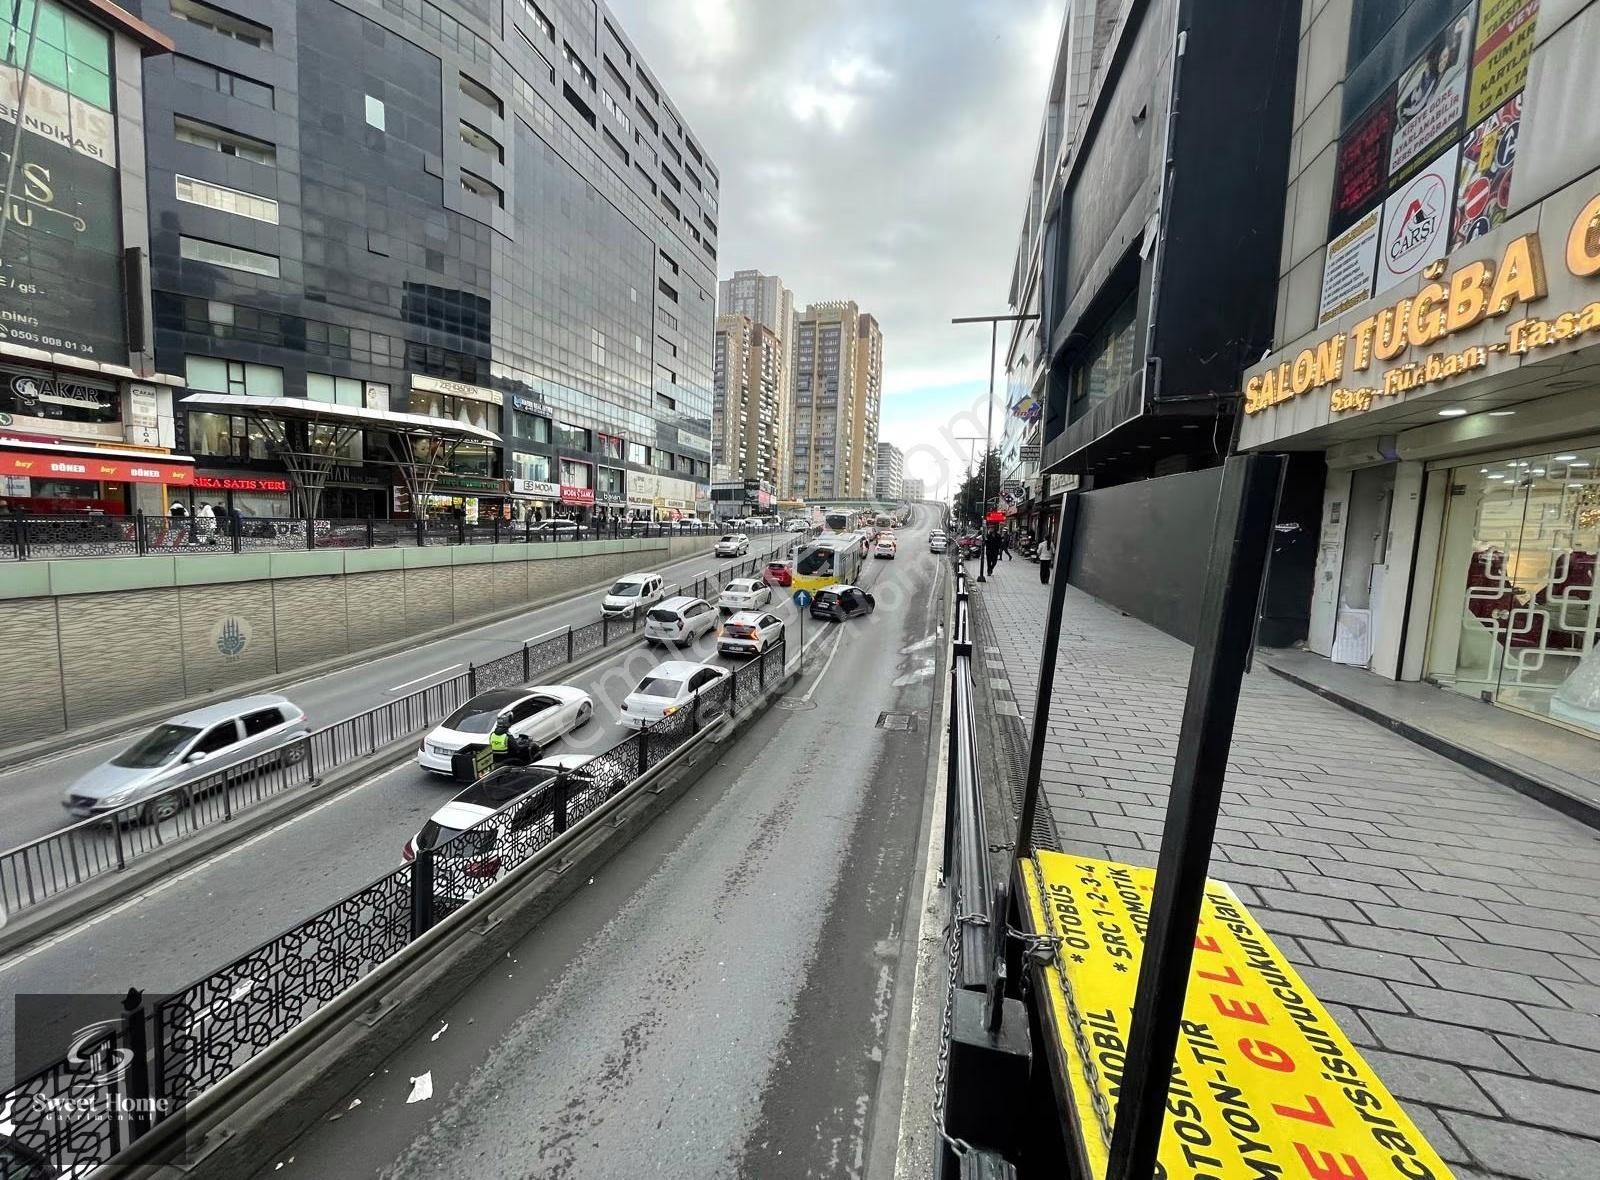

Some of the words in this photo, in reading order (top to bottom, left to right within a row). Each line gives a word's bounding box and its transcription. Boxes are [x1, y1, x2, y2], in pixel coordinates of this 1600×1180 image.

[0, 310, 39, 327] DİNG
[1243, 332, 1347, 416] SALON
[1350, 231, 1549, 372] TUĞBA
[10, 329, 39, 343] 0505
[42, 335, 62, 347] 008
[64, 340, 77, 350] 01
[51, 463, 86, 474] DÖNER
[130, 468, 161, 479] DÖNER
[258, 480, 286, 491] YERİ
[534, 482, 553, 493] MODA
[1075, 864, 1116, 918] 1-2-3-4
[1046, 883, 1090, 951] OTOBÜS
[1097, 921, 1134, 961] SRC
